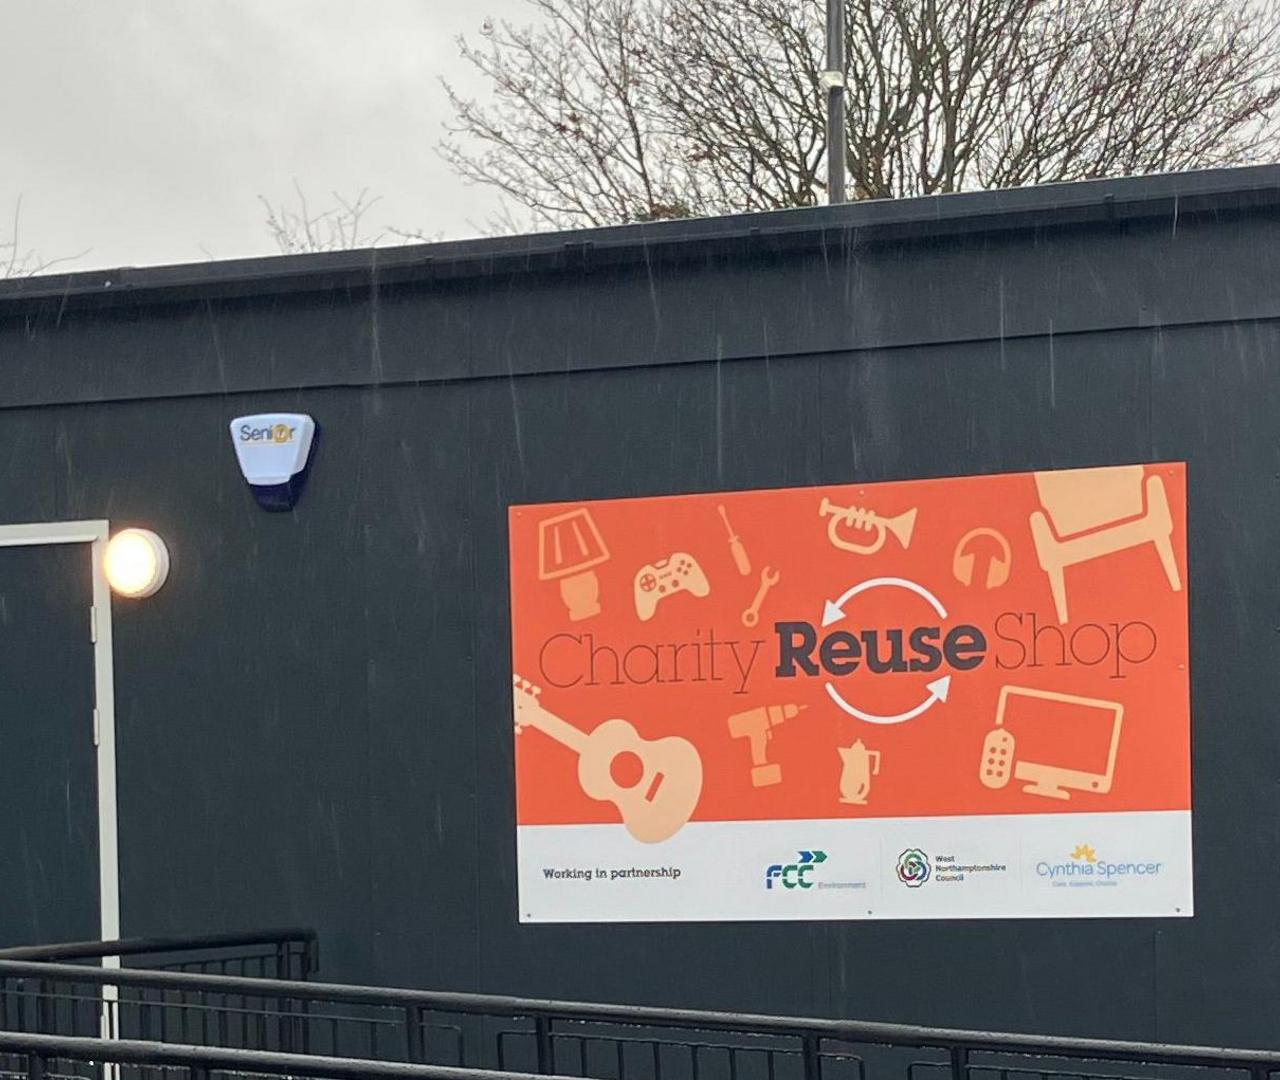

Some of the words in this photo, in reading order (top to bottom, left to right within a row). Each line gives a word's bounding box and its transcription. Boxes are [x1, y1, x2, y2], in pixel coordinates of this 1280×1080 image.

[240, 424, 296, 443] Senior
[539, 629, 766, 694] Charity
[774, 621, 987, 678] Reuse
[994, 612, 1157, 679] Shop
[543, 868, 592, 880] Working
[596, 867, 608, 878] in
[611, 867, 681, 880] partnership
[766, 864, 814, 889] FCC
[935, 864, 1006, 873] Northamptonshire
[1036, 862, 1094, 878] Cynthia
[1097, 861, 1162, 878] Spencer
[935, 874, 964, 882] Council
